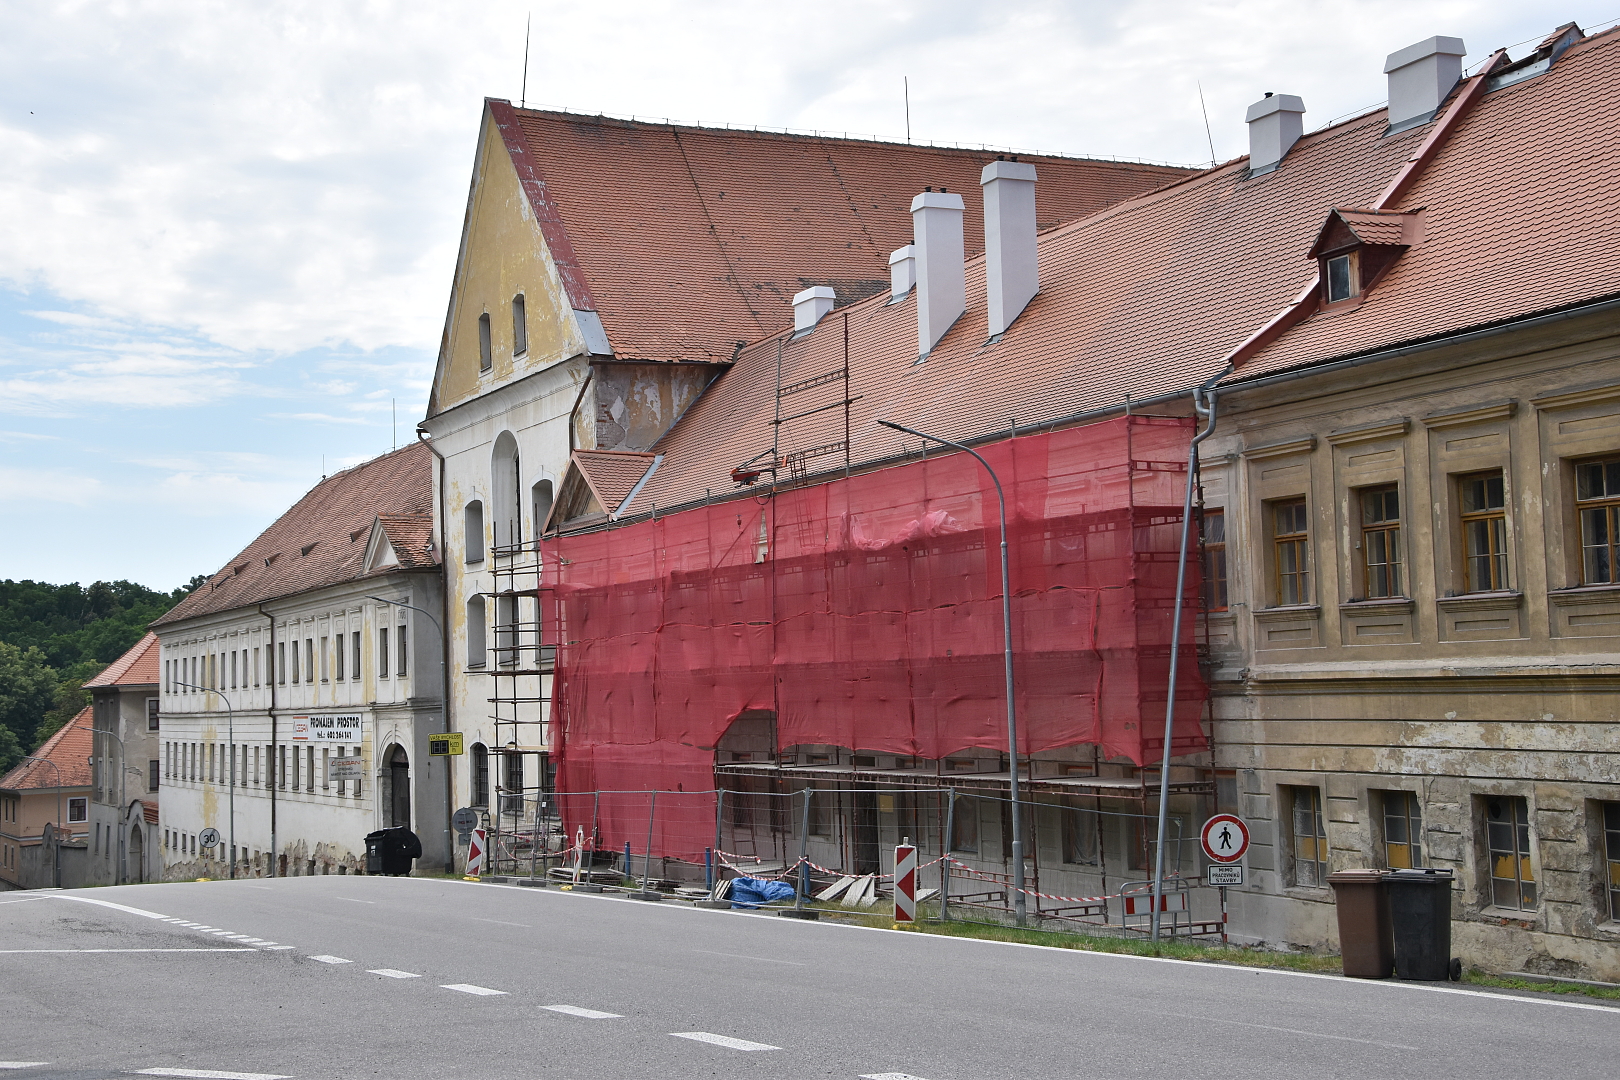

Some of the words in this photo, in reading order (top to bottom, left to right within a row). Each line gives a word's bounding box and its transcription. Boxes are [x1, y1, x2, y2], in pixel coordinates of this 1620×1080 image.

[310, 715, 335, 728] PRONÁJEM
[336, 716, 360, 728] PROSTOR
[203, 833, 216, 844] 30
